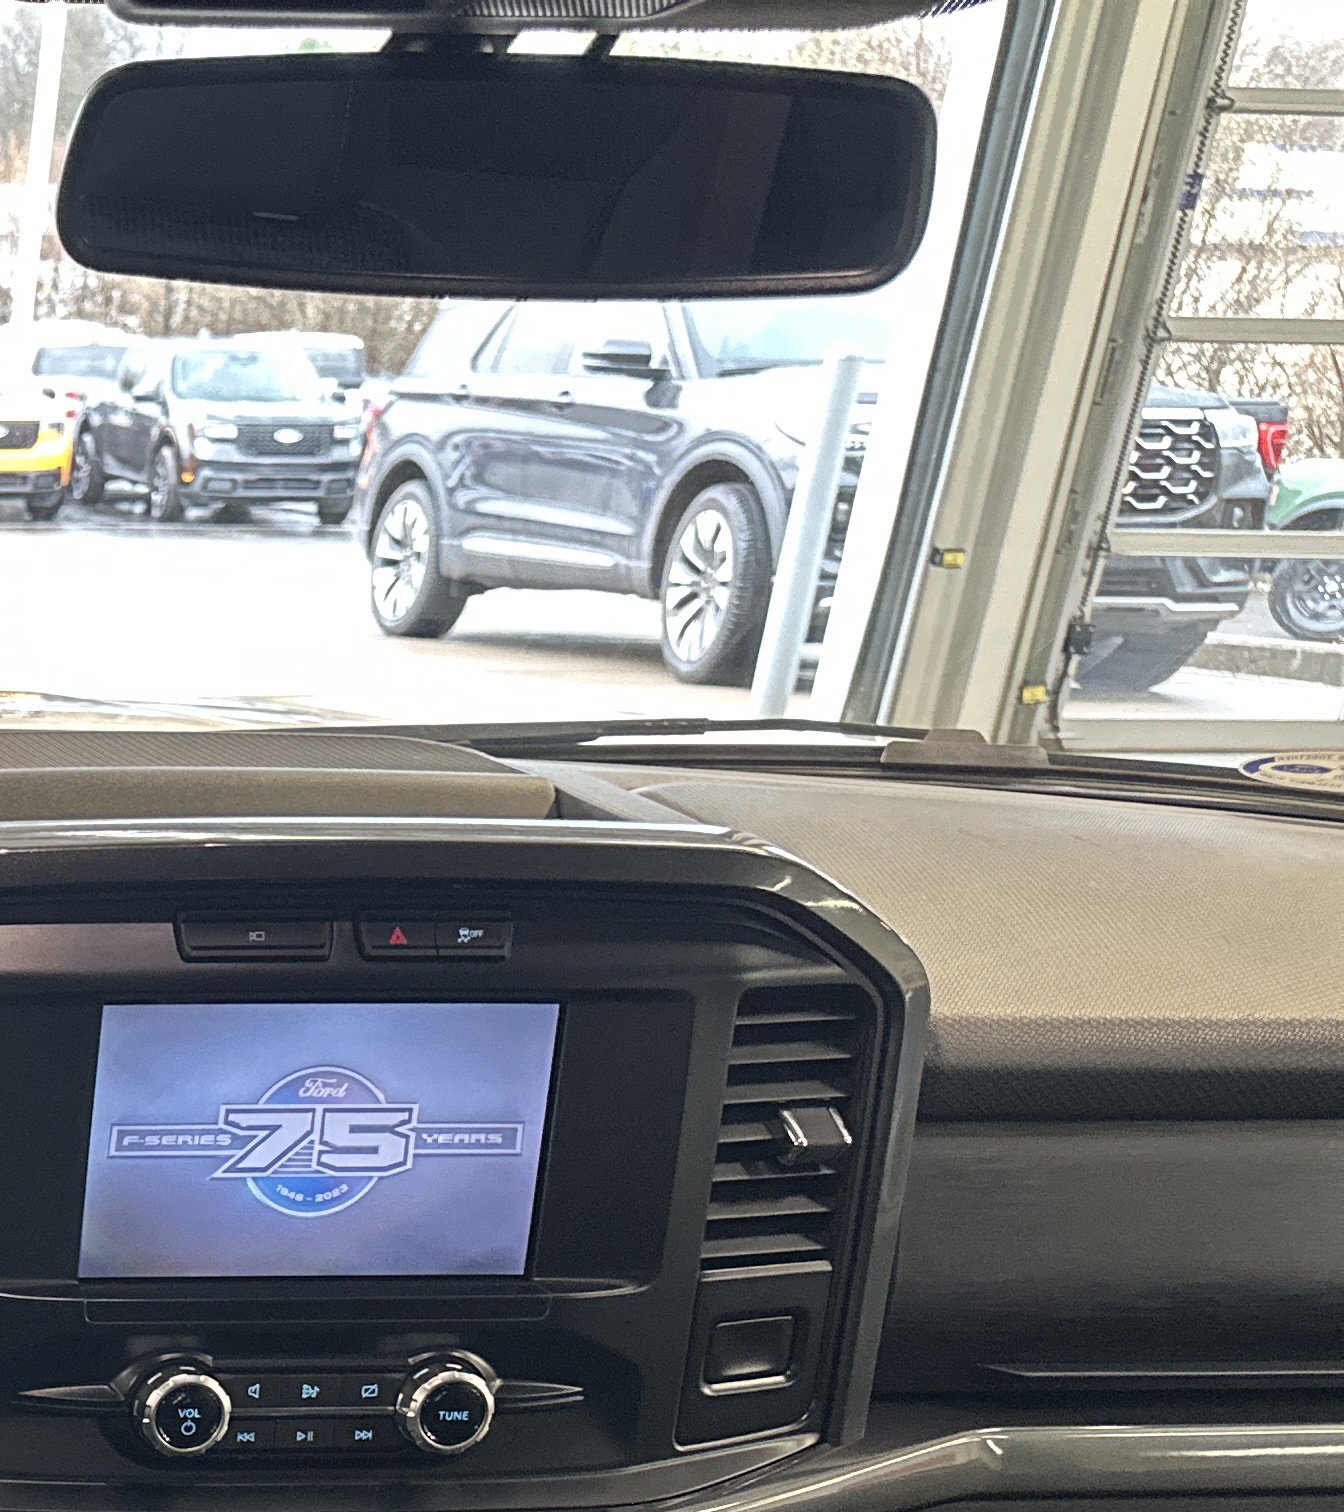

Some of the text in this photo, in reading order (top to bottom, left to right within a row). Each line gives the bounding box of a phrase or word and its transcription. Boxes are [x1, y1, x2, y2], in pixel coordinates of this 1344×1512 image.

[297, 1077, 350, 1099] Ford
[122, 1104, 504, 1177] F-SERIES 75 YEARS
[314, 1183, 349, 1202] 2023
[177, 1408, 201, 1419] VOL
[438, 1410, 470, 1421] TUNE
